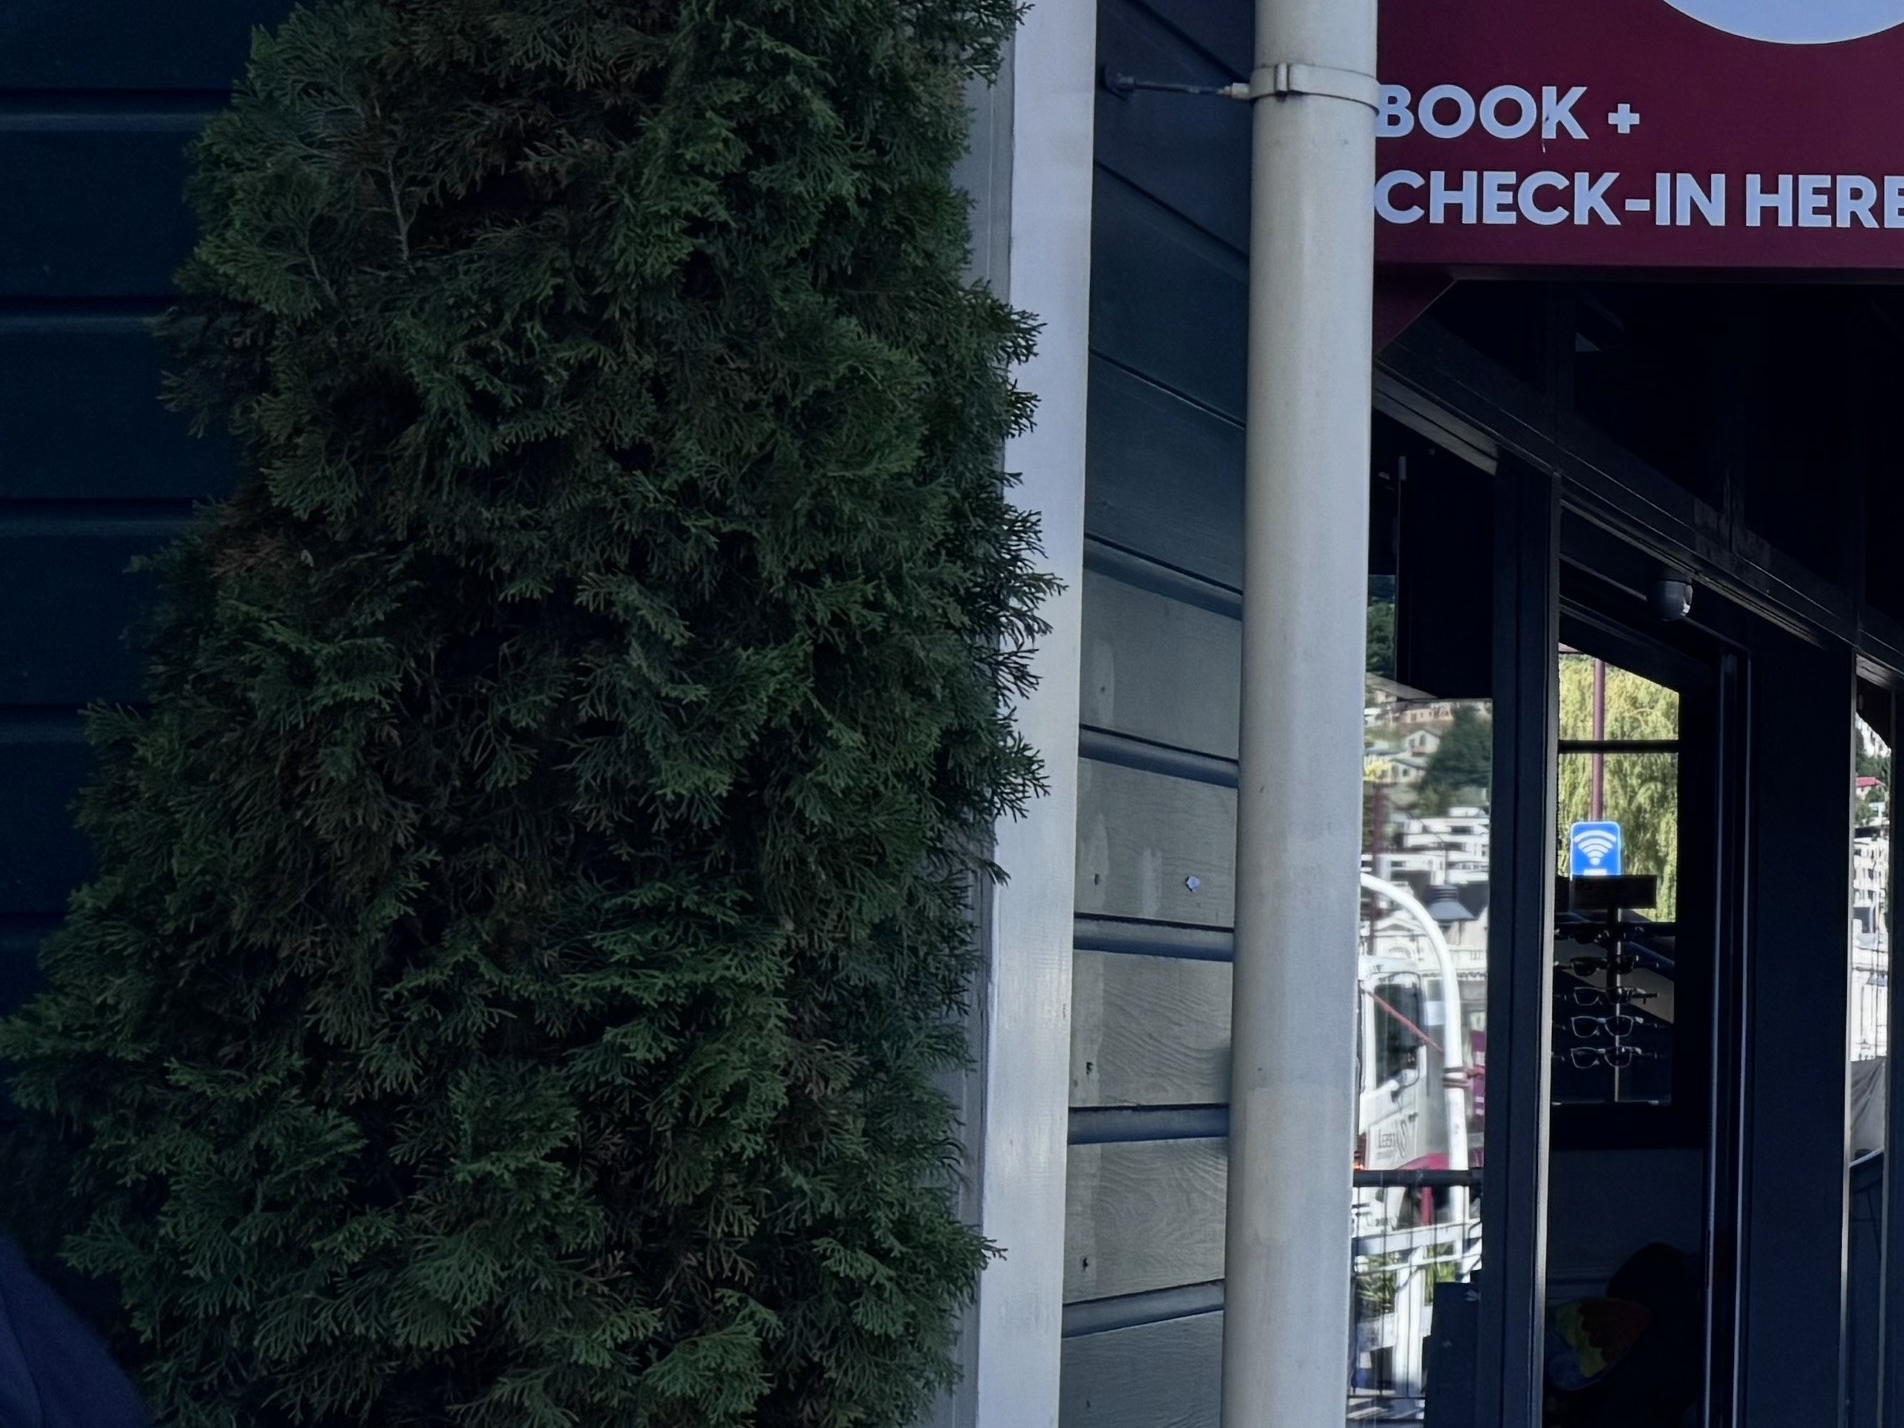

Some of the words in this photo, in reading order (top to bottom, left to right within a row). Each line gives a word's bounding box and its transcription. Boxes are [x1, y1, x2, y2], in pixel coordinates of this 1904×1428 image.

[1376, 84, 1589, 139] BOOK
[1608, 103, 1640, 134] +
[1374, 169, 1725, 226] CHECK-IN
